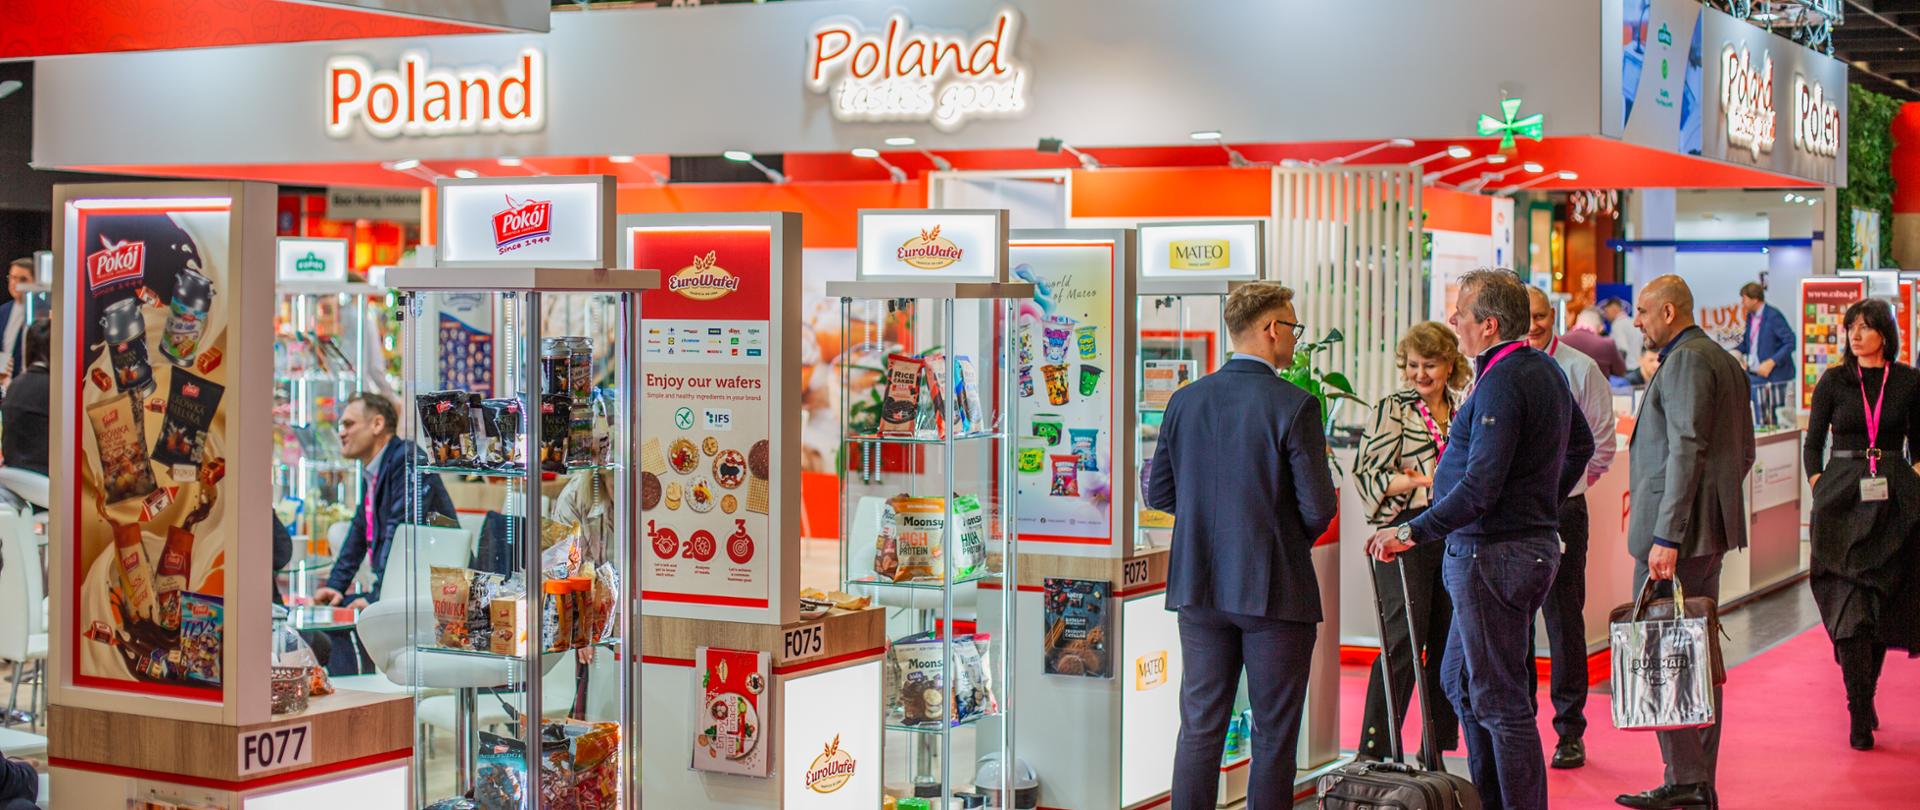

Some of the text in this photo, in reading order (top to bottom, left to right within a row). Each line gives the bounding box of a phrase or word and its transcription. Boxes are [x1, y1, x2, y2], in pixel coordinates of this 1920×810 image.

[814, 16, 1007, 79] Poland
[332, 56, 531, 125] Poland
[1727, 50, 1774, 113] Poland
[838, 79, 931, 111] tastes
[1801, 83, 1840, 150] Polen
[502, 204, 545, 233] Pokój
[499, 236, 551, 255] Since 1949
[896, 245, 963, 260] EuroWafel
[1175, 245, 1223, 260] MATEO
[96, 245, 139, 275] Pokój
[669, 274, 738, 290] EuroWafel
[1053, 288, 1097, 303] of Mateo
[646, 373, 761, 390] Enjoy our wafers
[894, 371, 915, 379] RICE
[714, 414, 729, 424] IFS
[647, 519, 657, 537] 1
[735, 519, 746, 537] 3
[903, 516, 944, 529] Moonsy
[899, 532, 928, 546] HIGH
[682, 541, 694, 559] 2
[899, 547, 928, 556] PROTEIN
[1123, 560, 1148, 585] F073
[785, 626, 822, 659] F075
[908, 658, 943, 670] Moons
[1139, 657, 1165, 677] MATEO
[244, 725, 308, 771] F077
[805, 759, 856, 787] EuroWafel
